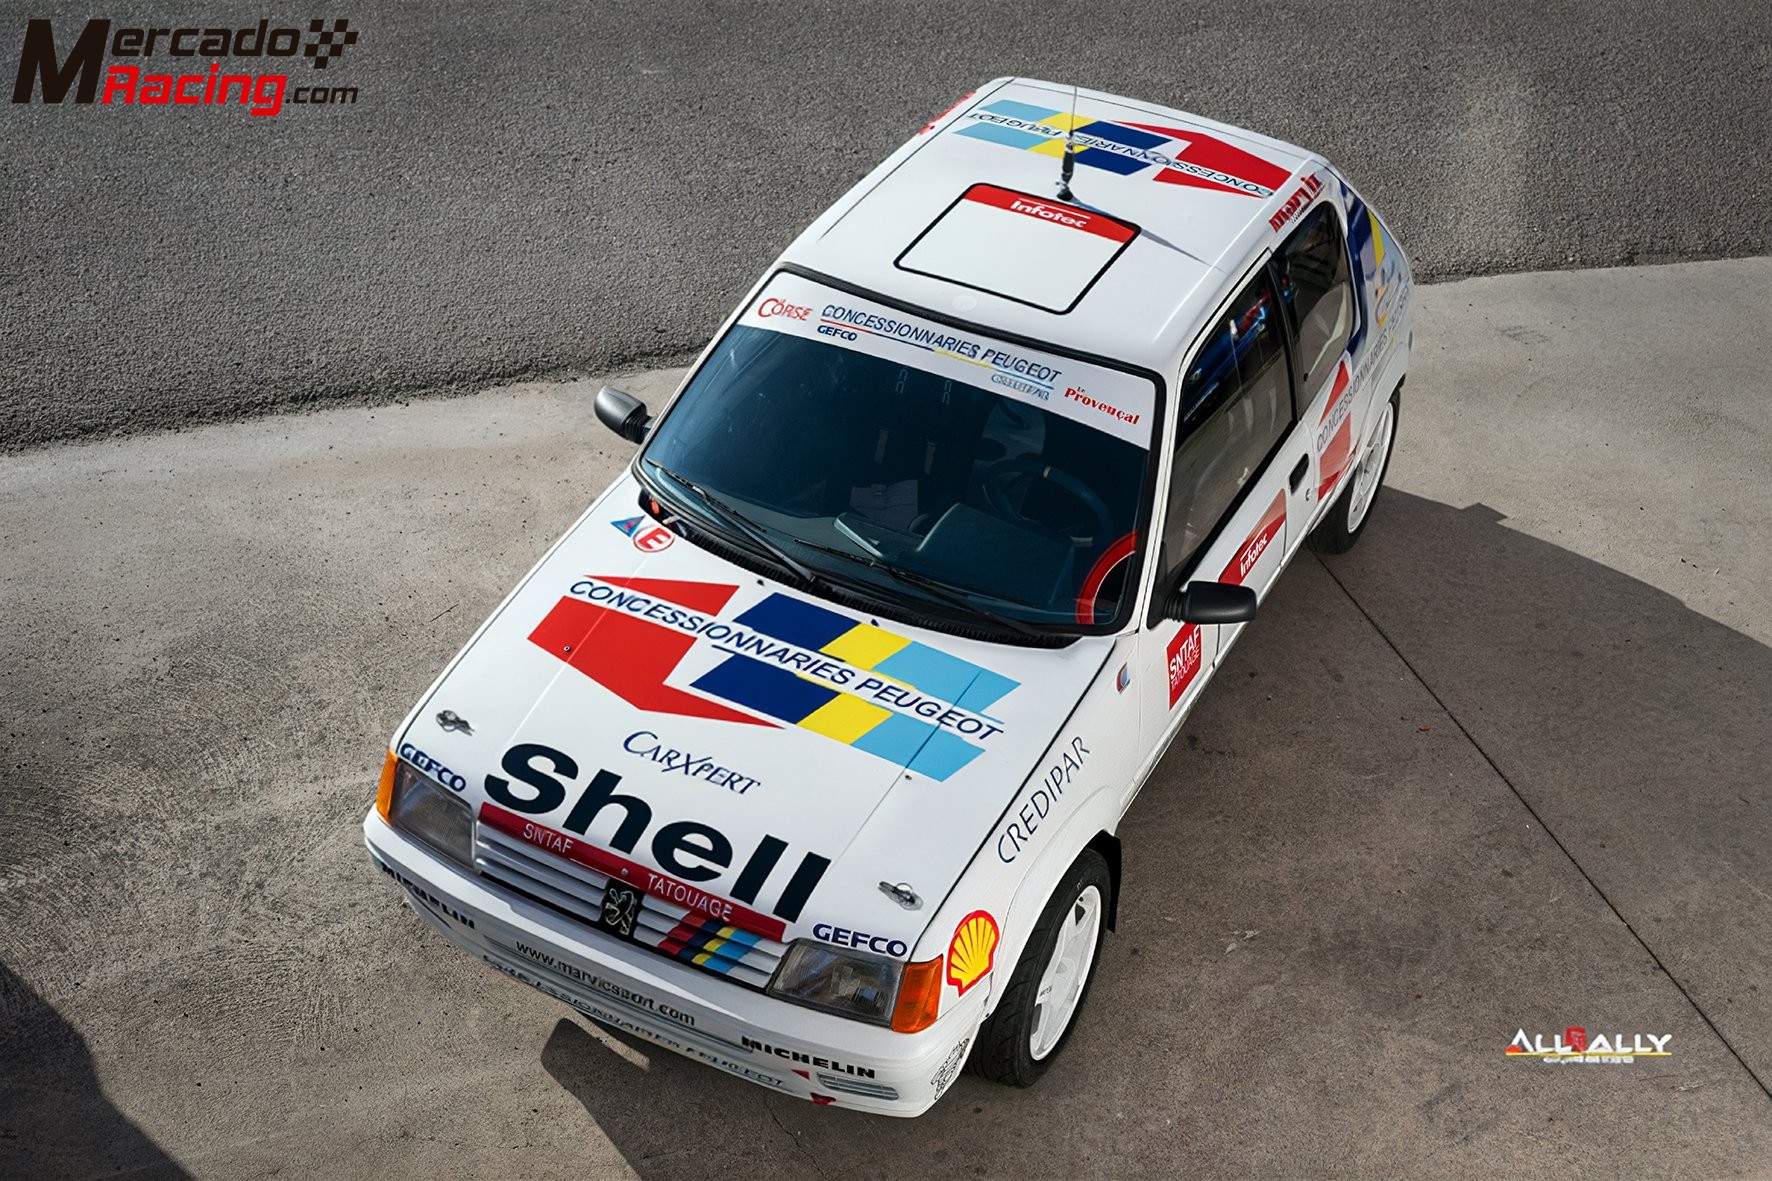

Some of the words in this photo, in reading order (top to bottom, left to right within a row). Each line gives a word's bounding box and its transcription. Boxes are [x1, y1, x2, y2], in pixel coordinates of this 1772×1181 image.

[1010, 199, 1087, 228] Infotec
[817, 324, 857, 341] GEFCO
[821, 304, 980, 358] CONCESSIONNARIES
[982, 347, 1062, 383] PEUGEOT
[1064, 387, 1140, 425] Provençal
[638, 528, 671, 549] E
[1239, 532, 1268, 578] Infotec
[570, 580, 856, 684] CONCESSIONNARIES
[854, 678, 1004, 742] PEUGEOT
[1169, 624, 1200, 680] SNTAF
[400, 742, 466, 792] GEFCO
[997, 736, 1090, 863] CREDIPAR
[484, 743, 832, 923] Shell
[522, 822, 574, 854] SNTAF
[647, 872, 734, 922] TATOUAGE
[812, 923, 909, 958] GEFCO
[741, 1035, 876, 1079] MICHELIN
